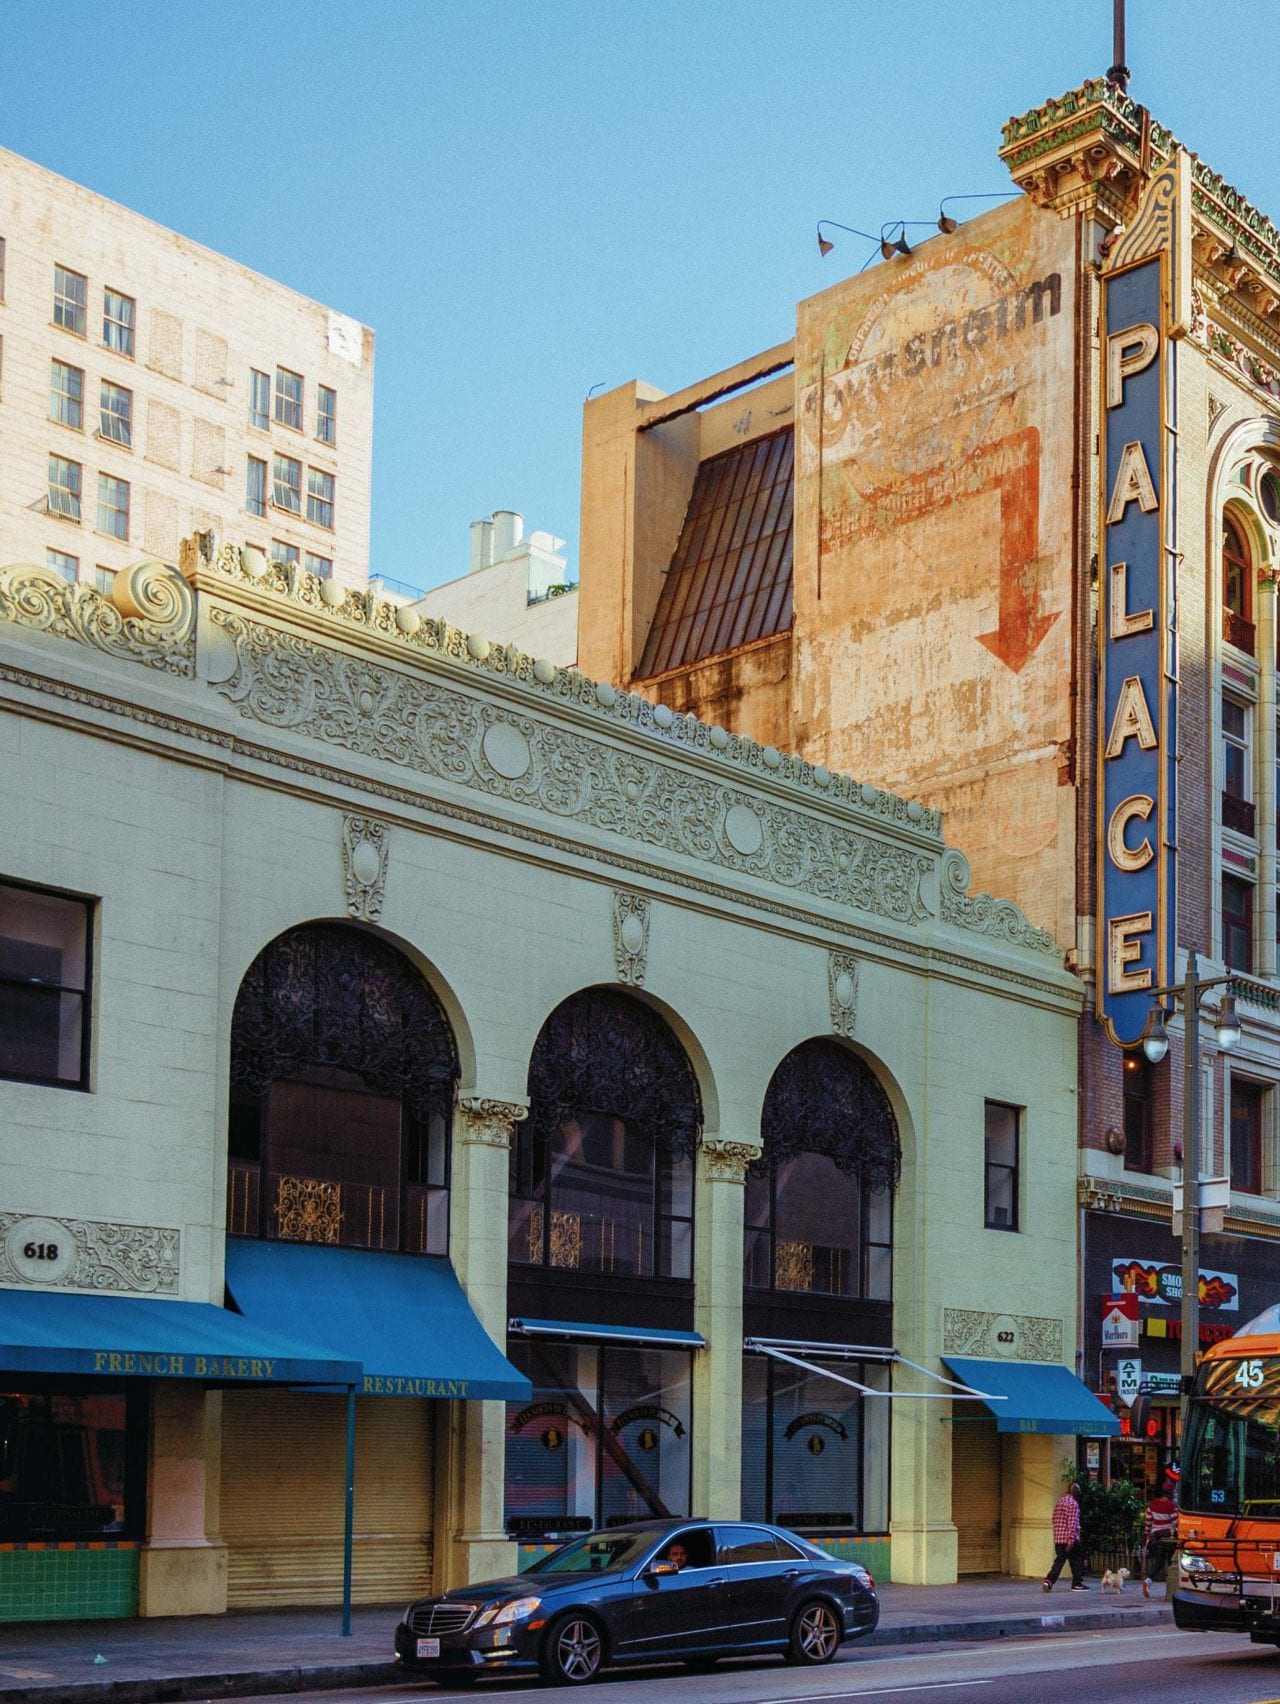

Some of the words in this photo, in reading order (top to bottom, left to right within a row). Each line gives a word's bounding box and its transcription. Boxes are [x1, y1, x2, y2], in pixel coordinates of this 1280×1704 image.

[1105, 322, 1160, 996] PALACE
[24, 1242, 58, 1260] 618
[1166, 1286, 1183, 1299] SHO
[997, 1331, 1015, 1344] 622
[1104, 1325, 1129, 1340] Marlboro
[95, 1352, 184, 1375] FRENCH
[194, 1356, 276, 1378] BAKERY
[1121, 1361, 1138, 1389] ATM
[1234, 1361, 1264, 1388] 45
[363, 1376, 469, 1397] RESTAURANT
[1019, 1419, 1039, 1432] BAR
[1211, 1489, 1225, 1503] 53
